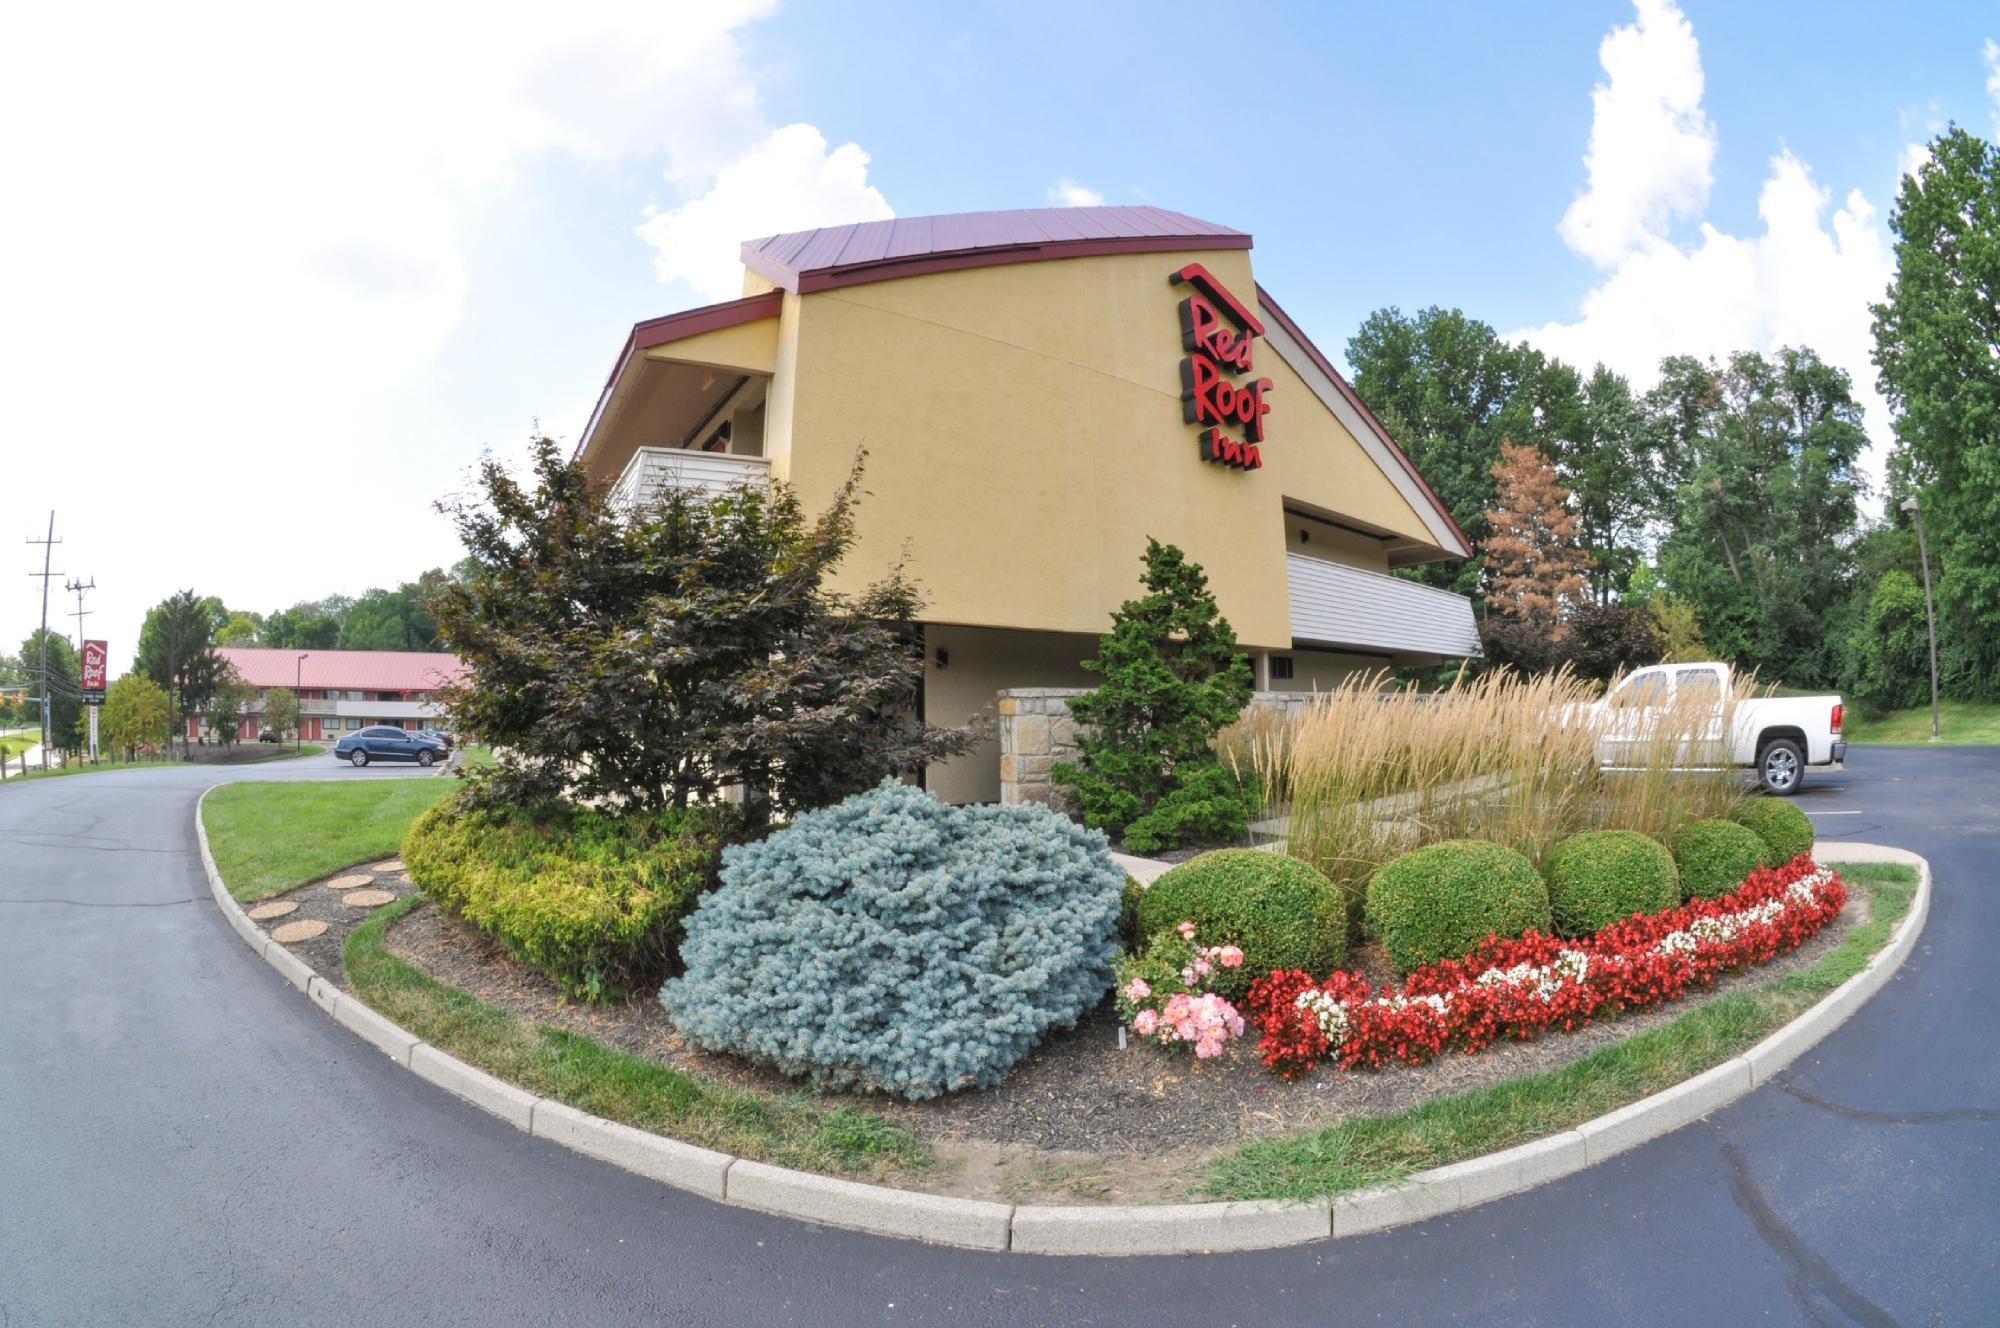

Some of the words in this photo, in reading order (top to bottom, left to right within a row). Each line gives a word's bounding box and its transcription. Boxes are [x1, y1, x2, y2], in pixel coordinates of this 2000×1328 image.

[1191, 294, 1254, 371] Red
[1191, 353, 1274, 442] Roof
[1211, 427, 1262, 469] Inn
[85, 665, 105, 681] Roof
[87, 651, 102, 665] Red
